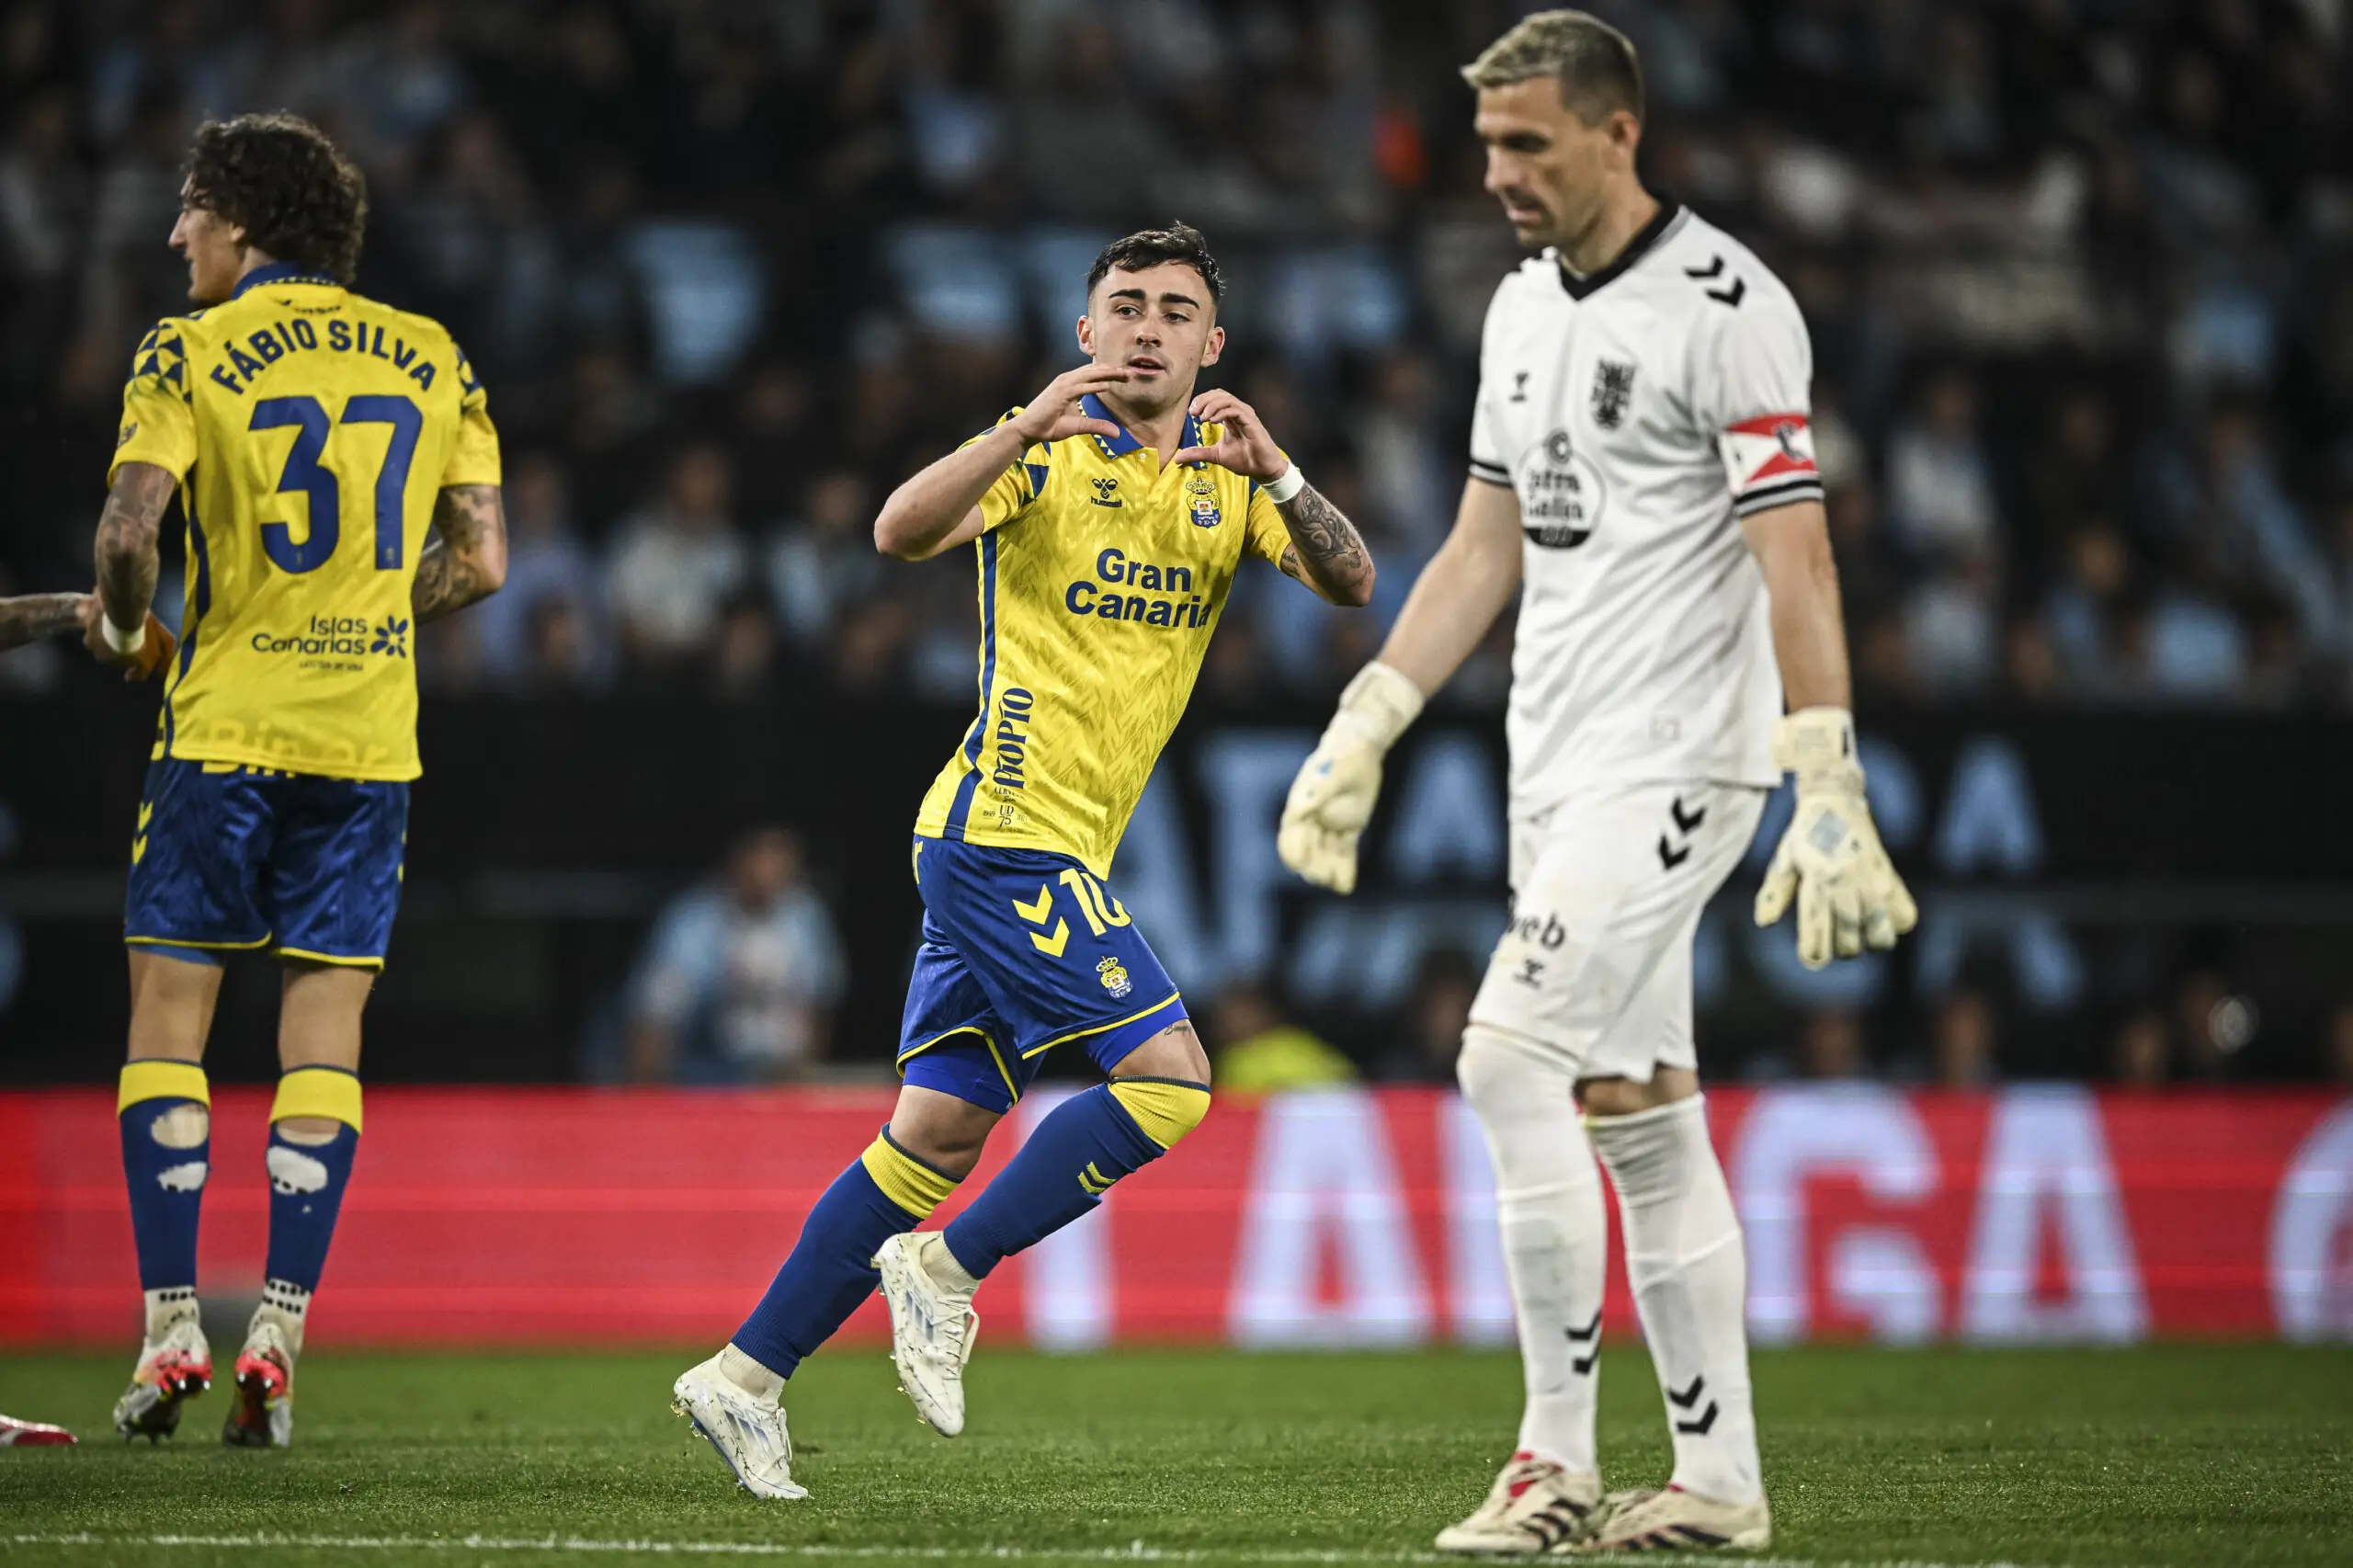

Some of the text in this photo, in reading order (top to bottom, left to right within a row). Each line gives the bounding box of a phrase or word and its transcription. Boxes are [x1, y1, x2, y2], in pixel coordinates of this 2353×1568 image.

[210, 319, 437, 395] FÁBIO SILVA
[248, 394, 424, 574] 37
[1091, 495, 1122, 507] hummel
[1096, 548, 1192, 593] Gran
[1064, 580, 1212, 629] Canaria
[310, 615, 368, 635] Islas
[251, 632, 367, 655] Canarias
[998, 815, 1012, 828] 75
[999, 805, 1015, 815] UD
[1059, 868, 1132, 937] 10
